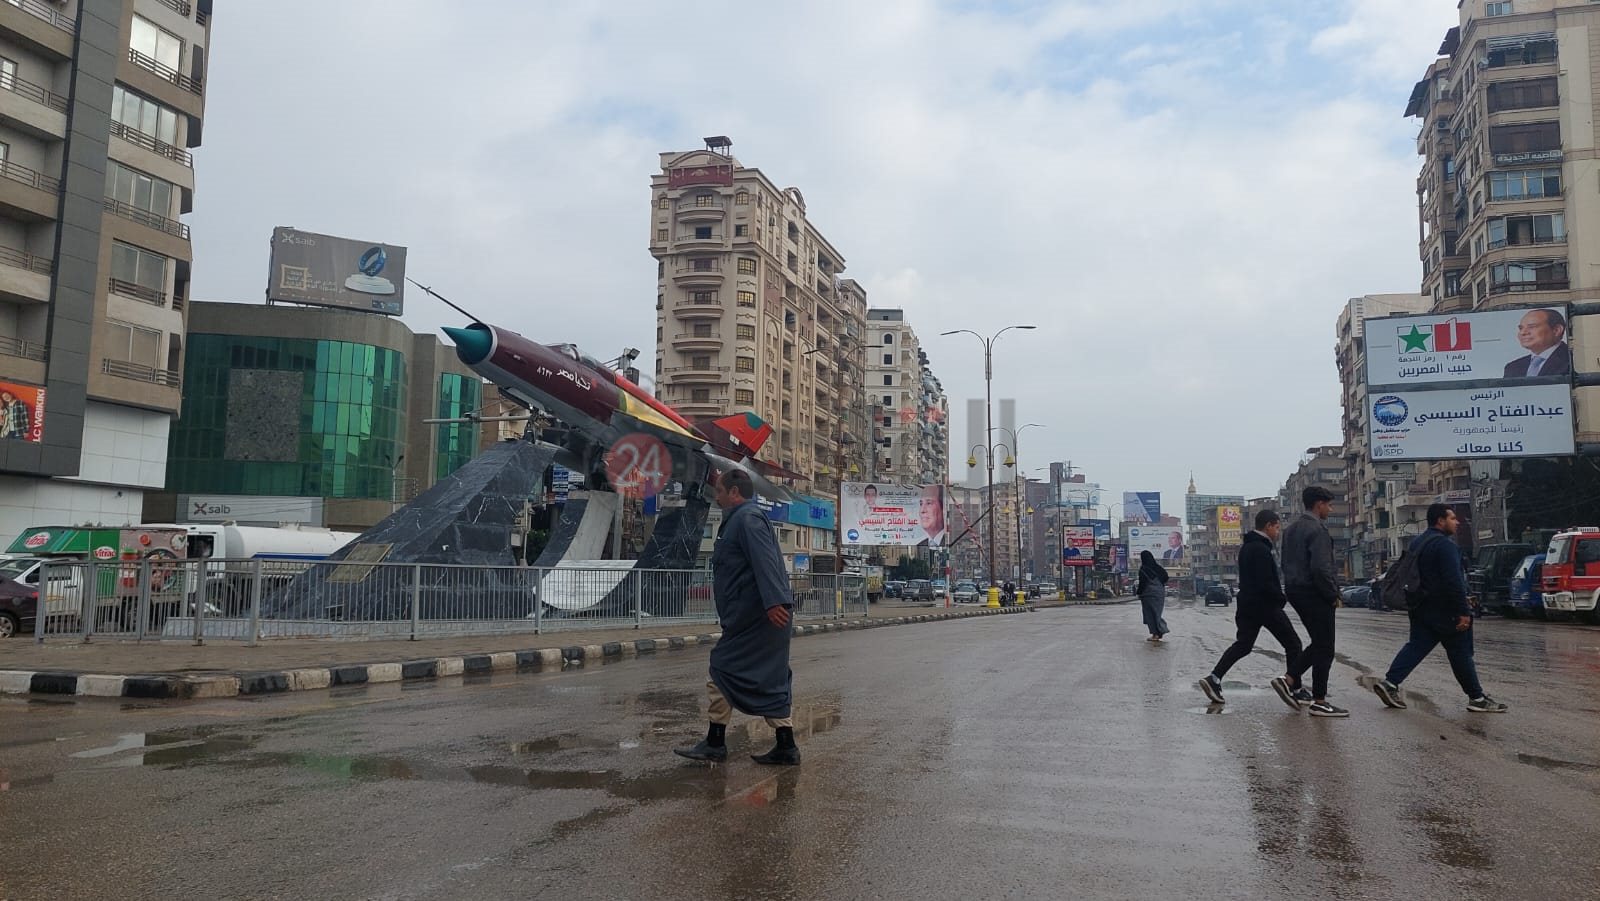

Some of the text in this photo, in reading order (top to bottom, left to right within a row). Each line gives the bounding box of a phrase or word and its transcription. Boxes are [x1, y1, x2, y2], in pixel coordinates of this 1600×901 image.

[1452, 354, 1466, 362] رقم
[1398, 363, 1472, 377] حبيب المصريين
[1470, 390, 1504, 401] الرئيس
[1414, 405, 1564, 427] عبدالفتاح السيسي
[1452, 426, 1497, 436] للجمهورية
[1456, 441, 1524, 454] كلنا معاك
[208, 503, 231, 514] saib
